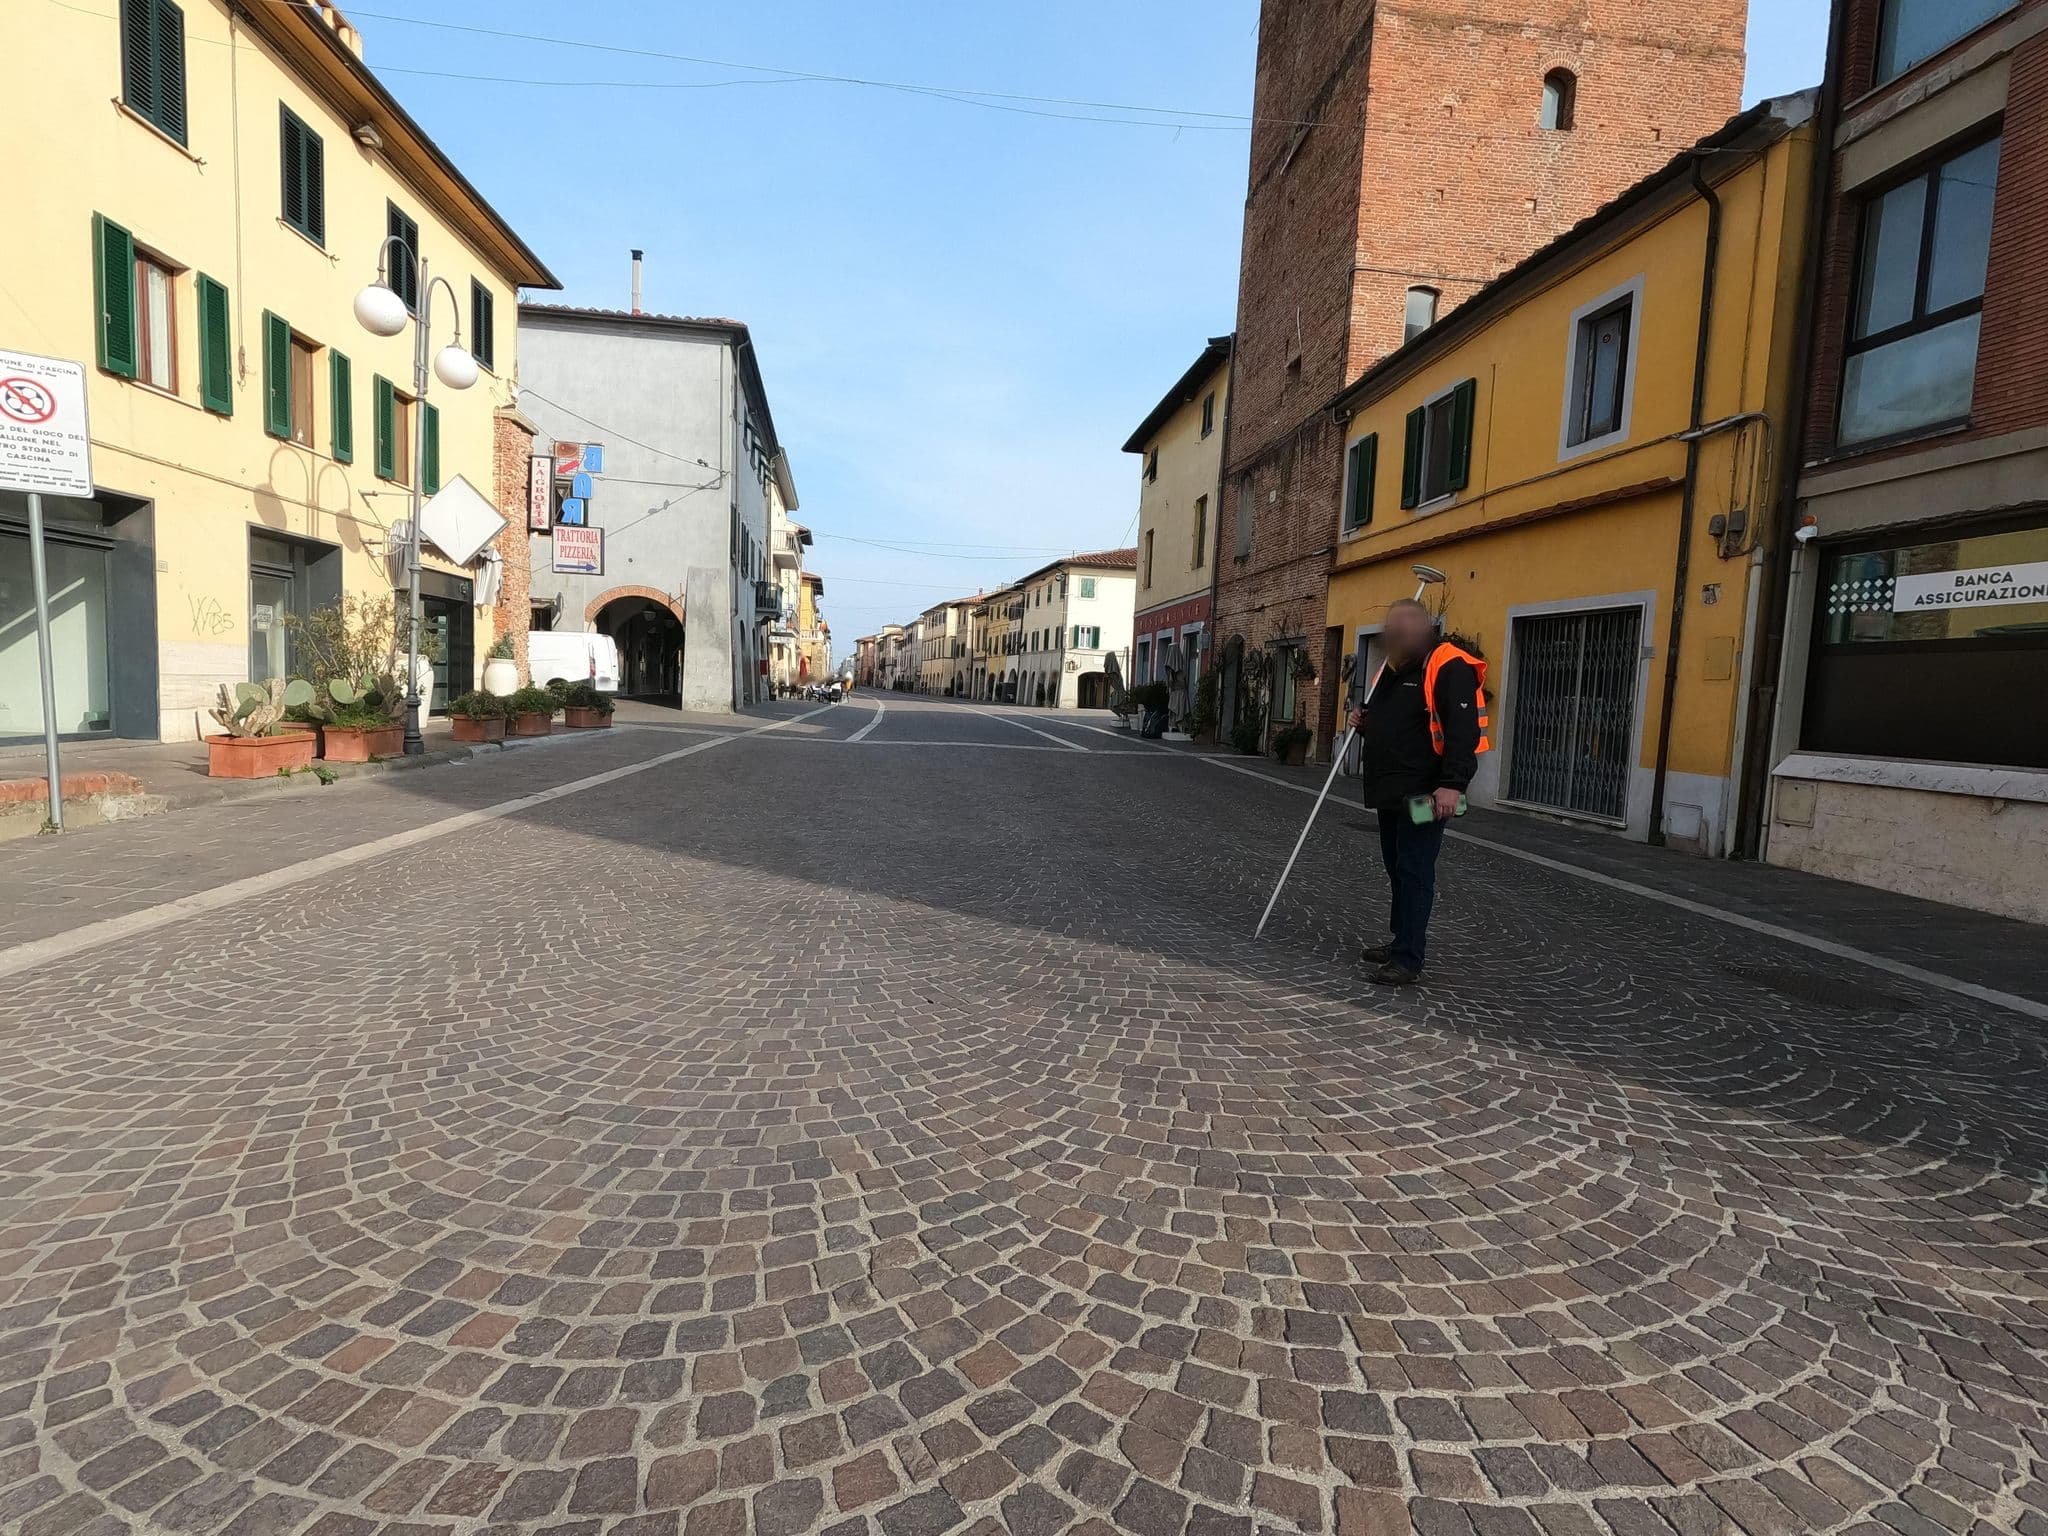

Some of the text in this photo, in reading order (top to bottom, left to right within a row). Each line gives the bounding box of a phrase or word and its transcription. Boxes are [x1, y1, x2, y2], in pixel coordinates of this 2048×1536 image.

[39, 365, 78, 376] CASCINA
[0, 434, 61, 447] ALLONE NEL
[10, 426, 28, 434] DEL
[33, 429, 63, 438] GIOCO
[68, 433, 85, 441] DEL
[6, 452, 51, 463] CASCINA
[22, 445, 64, 456] STORICO
[555, 528, 599, 544] TRATTORIA
[559, 545, 595, 560] PIZZERIA
[1954, 571, 2014, 587] BANCA
